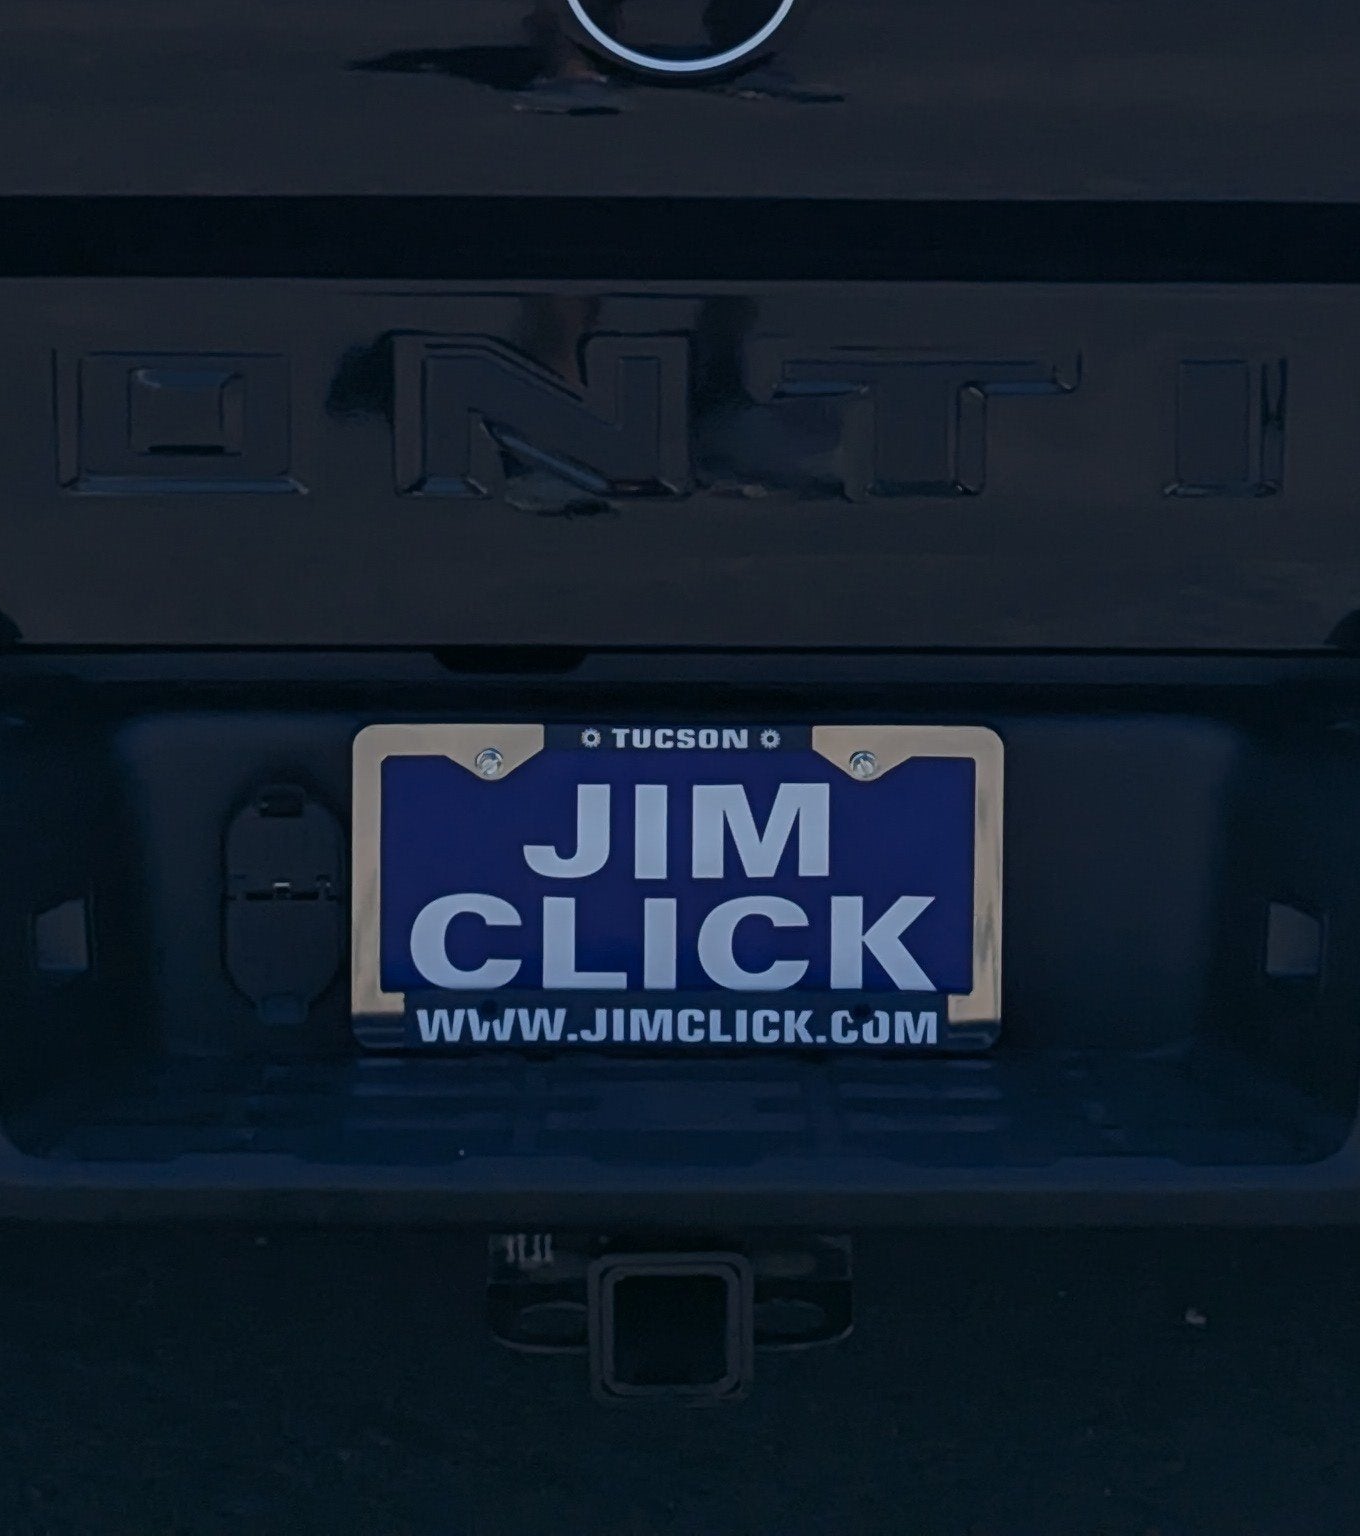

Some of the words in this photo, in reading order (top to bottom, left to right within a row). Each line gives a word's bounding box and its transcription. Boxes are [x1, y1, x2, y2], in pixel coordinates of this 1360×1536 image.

[611, 728, 750, 750] TUCSON
[522, 782, 830, 879] JIM
[409, 892, 938, 991] CLICK
[416, 1007, 939, 1045] WWW.JIMCLICK.COM
